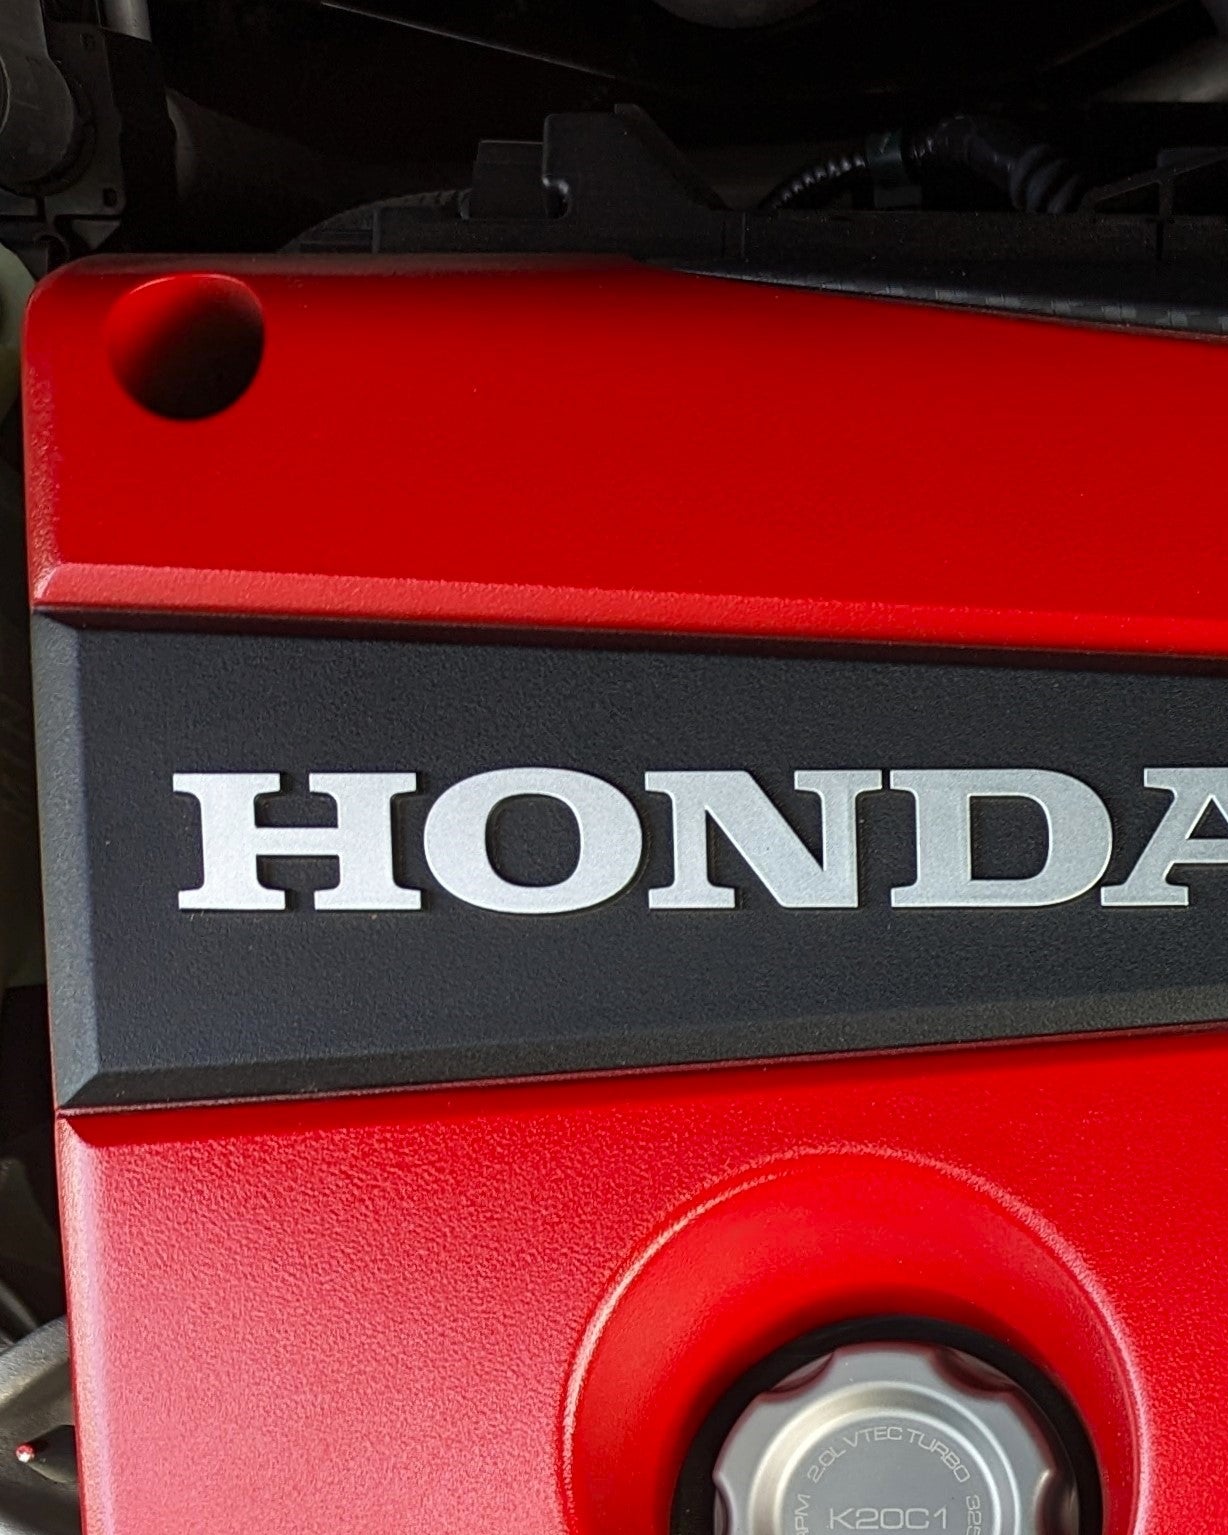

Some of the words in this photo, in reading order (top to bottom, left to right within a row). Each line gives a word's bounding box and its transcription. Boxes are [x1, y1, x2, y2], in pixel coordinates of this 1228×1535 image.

[806, 1446, 846, 1484] 2.0L
[843, 1425, 903, 1448] VTEC
[907, 1427, 971, 1483] TURBO
[829, 1507, 948, 1530] K20C1
